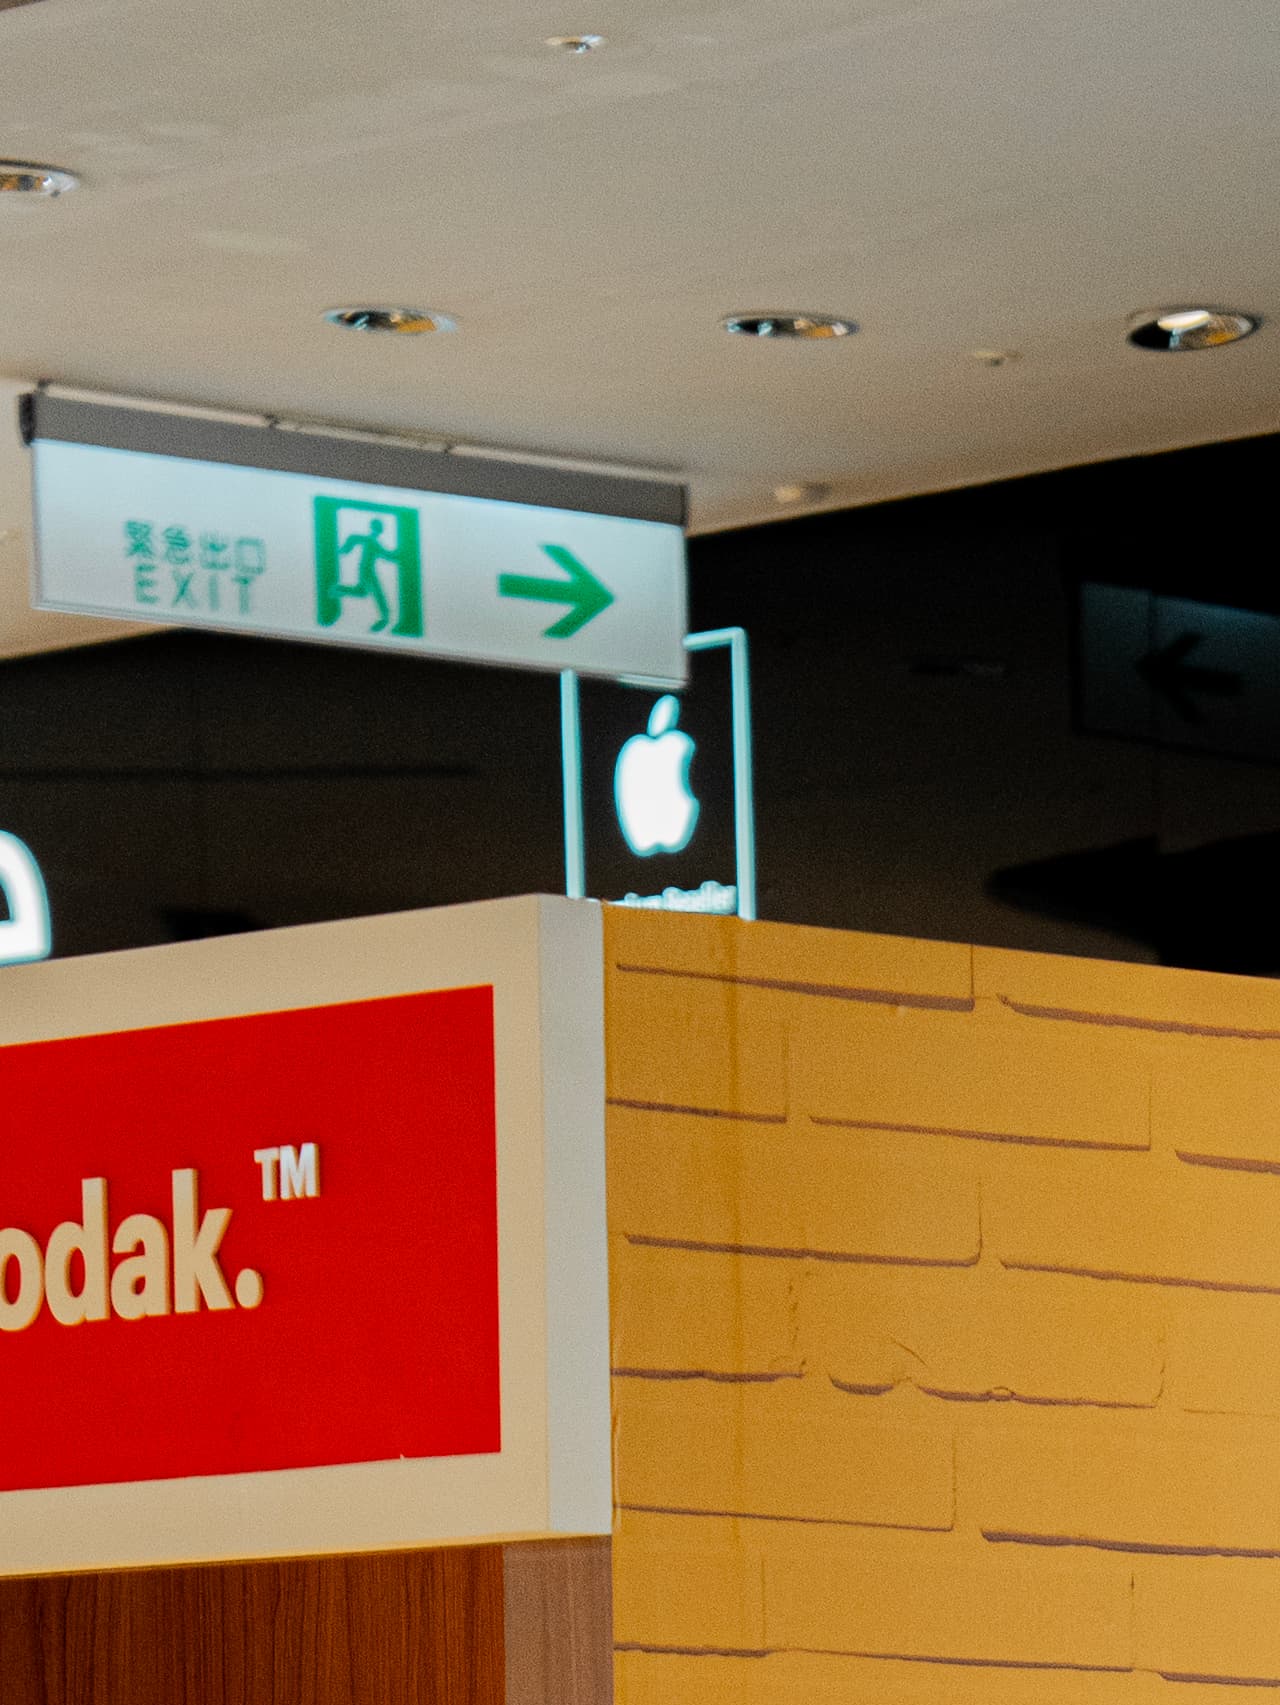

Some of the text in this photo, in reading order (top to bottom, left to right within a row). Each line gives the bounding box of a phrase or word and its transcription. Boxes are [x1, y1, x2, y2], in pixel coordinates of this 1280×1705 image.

[126, 520, 266, 575] 緊急出口
[135, 564, 255, 614] EXIT
